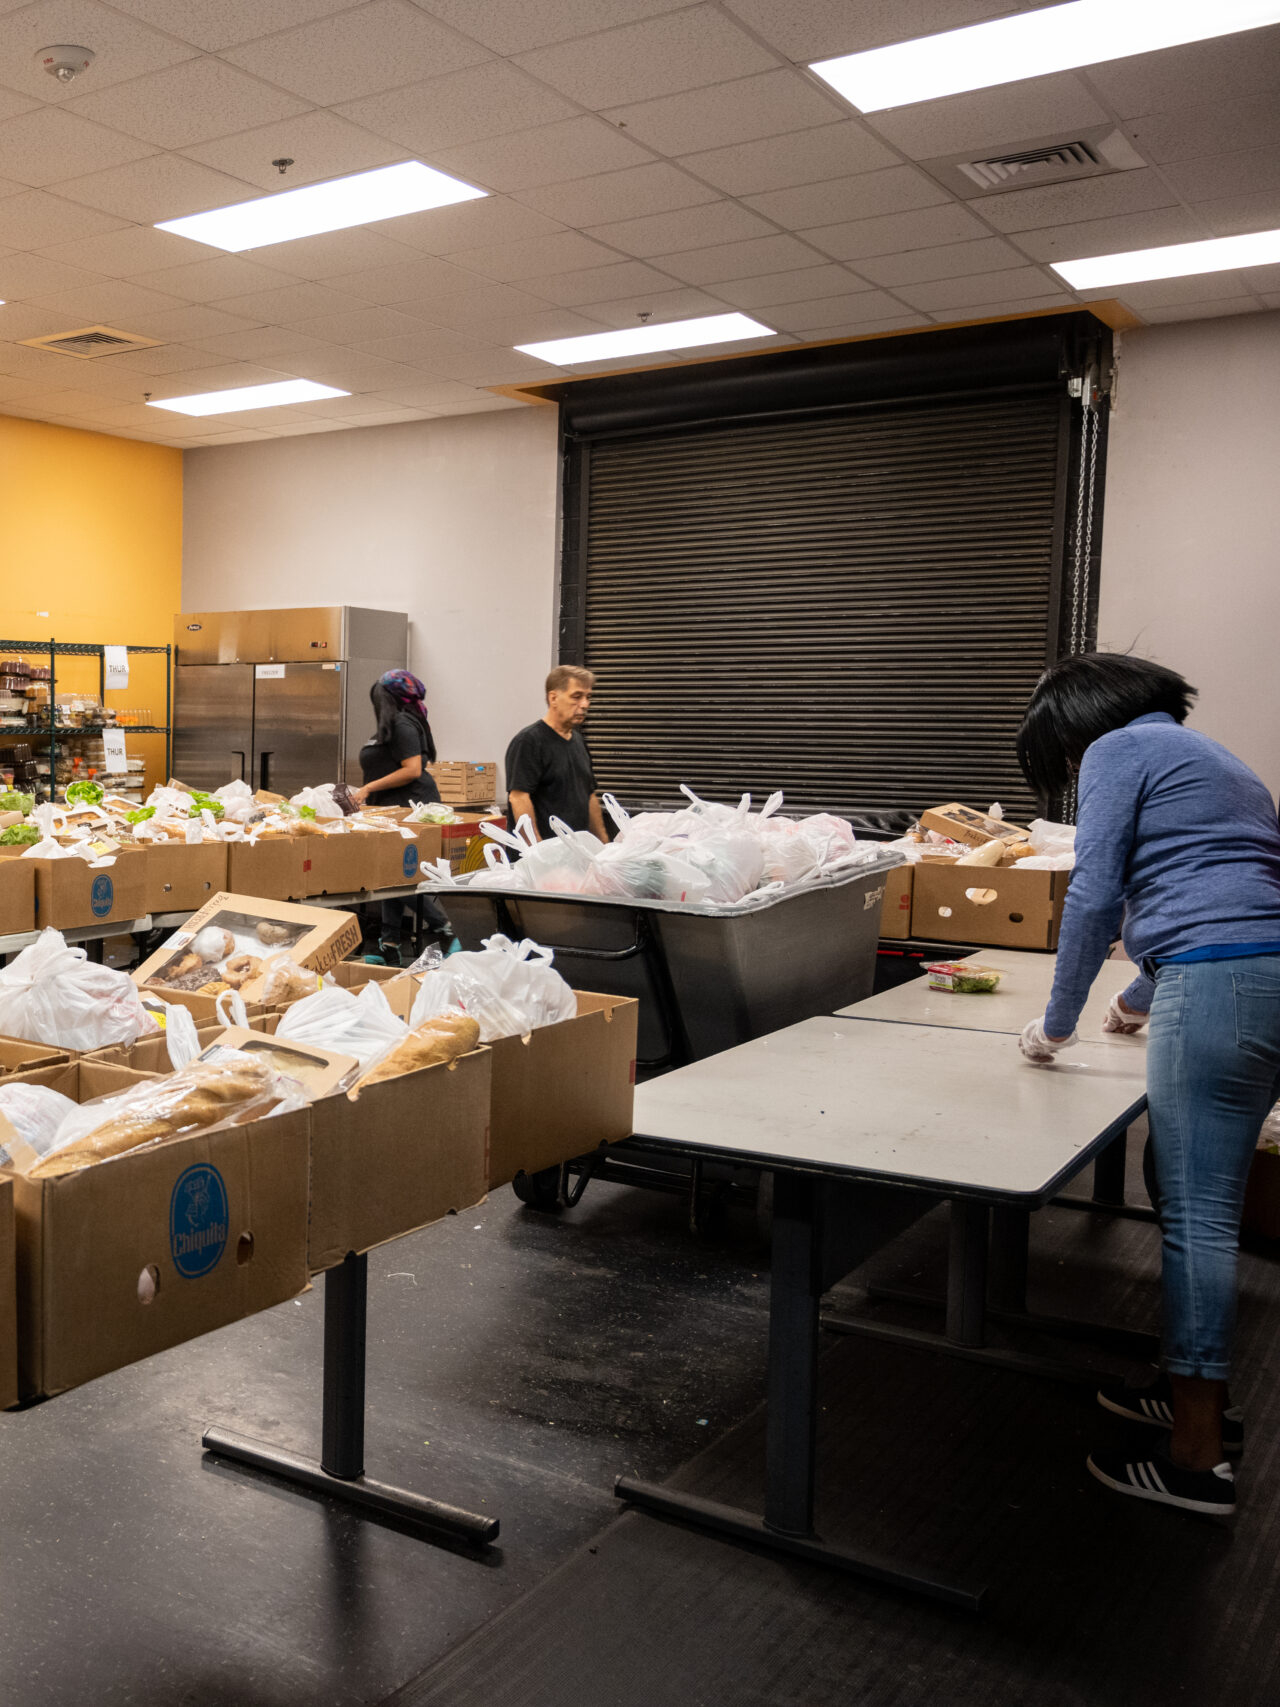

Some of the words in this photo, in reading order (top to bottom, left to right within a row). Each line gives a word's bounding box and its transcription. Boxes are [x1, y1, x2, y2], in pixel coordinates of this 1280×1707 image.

[109, 664, 126, 673] THUR
[107, 747, 123, 756] THUR
[174, 1222, 226, 1257] Chiquita
